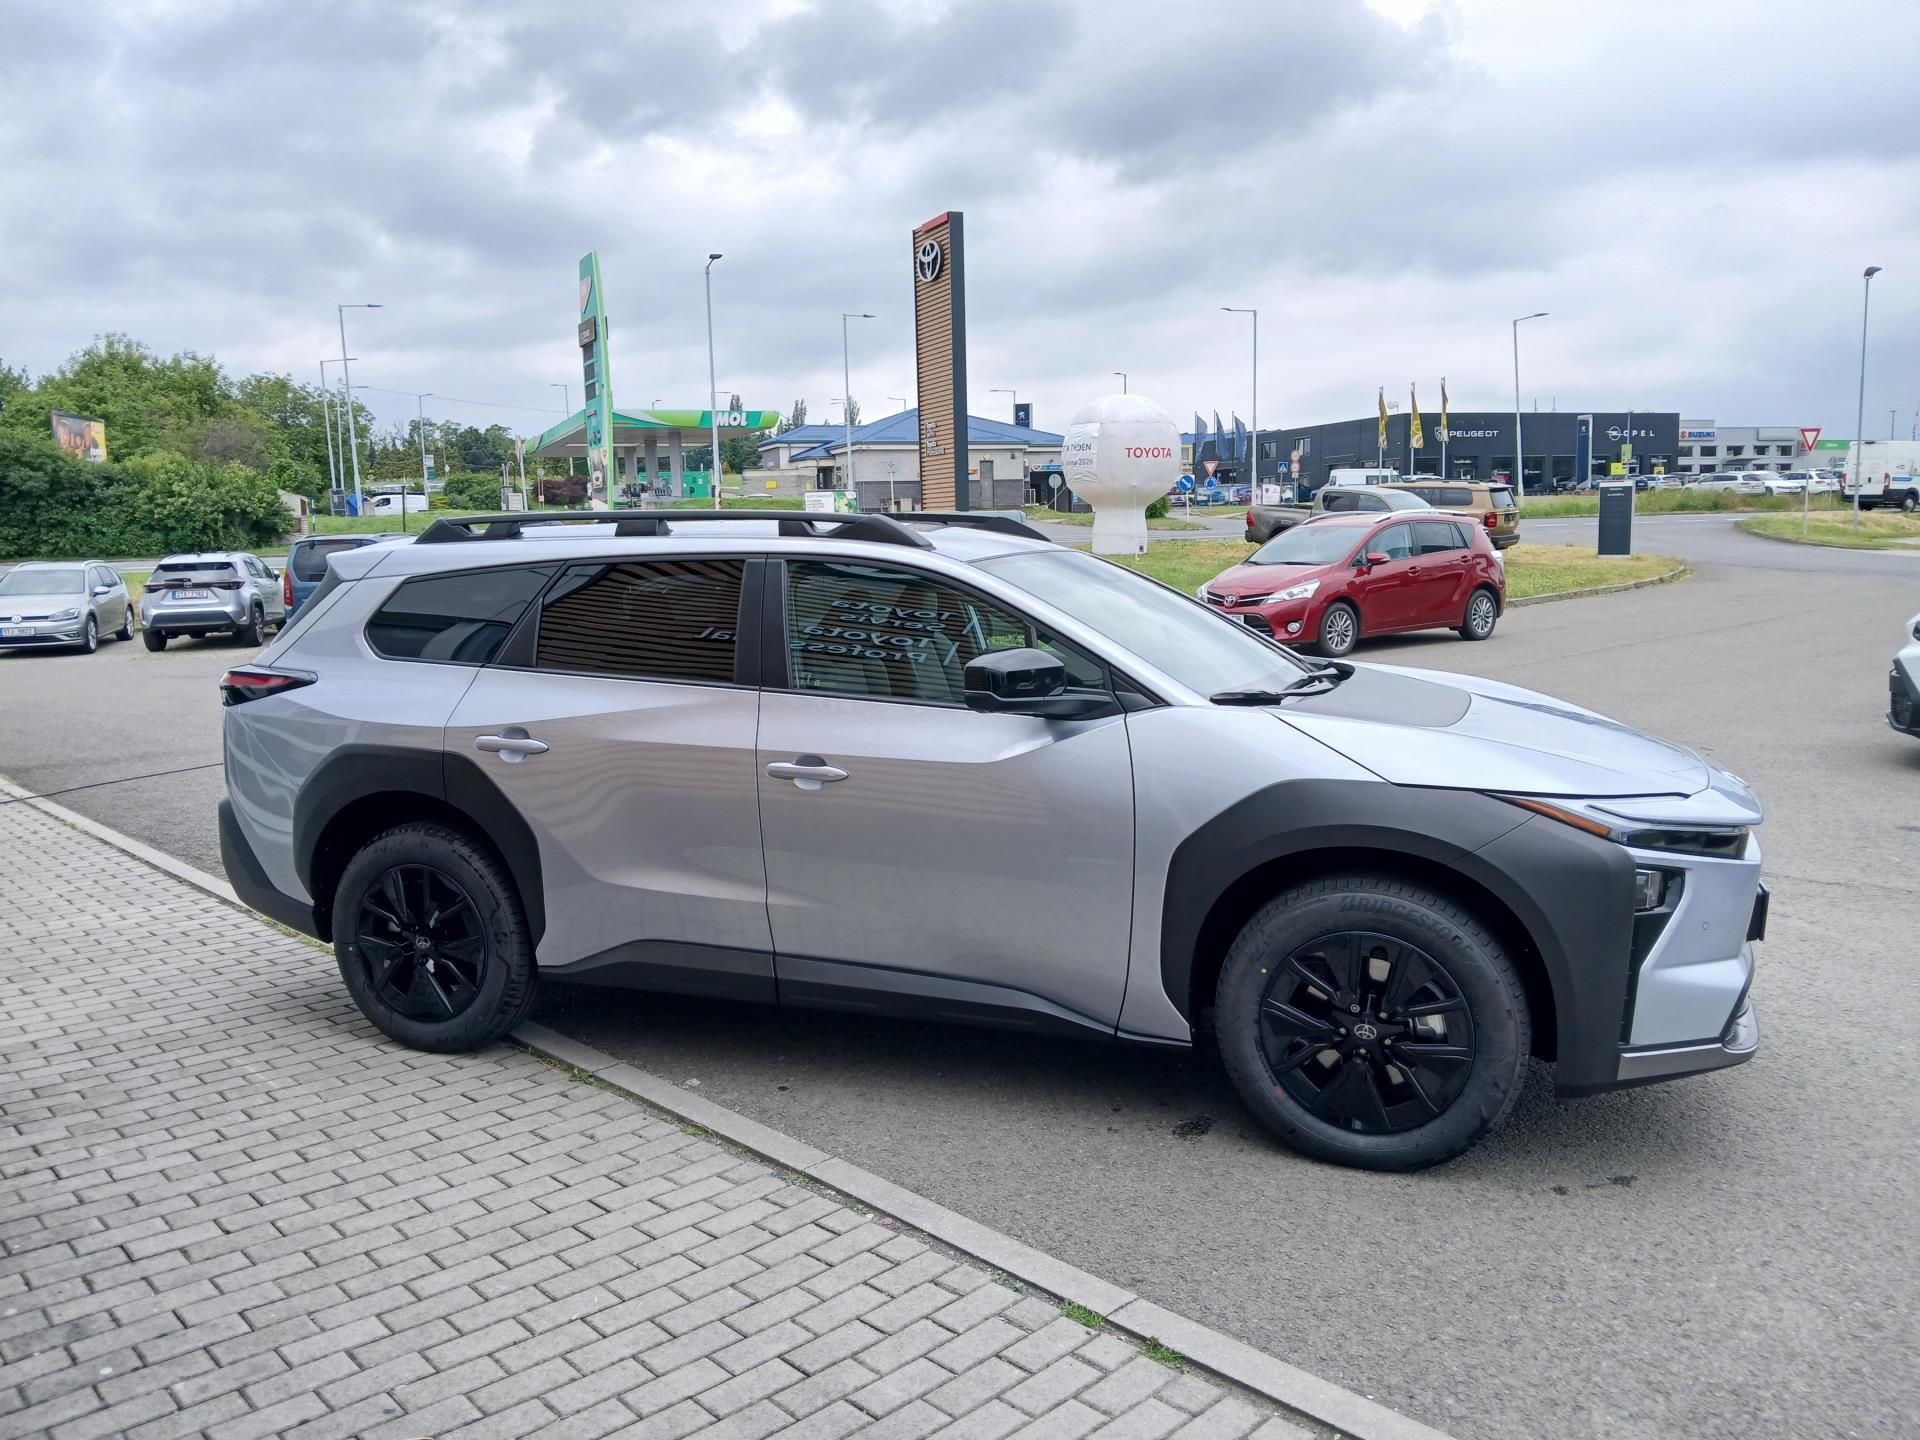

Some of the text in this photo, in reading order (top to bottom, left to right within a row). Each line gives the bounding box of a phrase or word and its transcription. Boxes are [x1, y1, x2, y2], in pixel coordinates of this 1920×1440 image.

[717, 411, 747, 427] MOL
[1449, 430, 1499, 438] PEUGEOT
[1623, 429, 1655, 437] OPEL
[1125, 447, 1172, 458] TOYOTA
